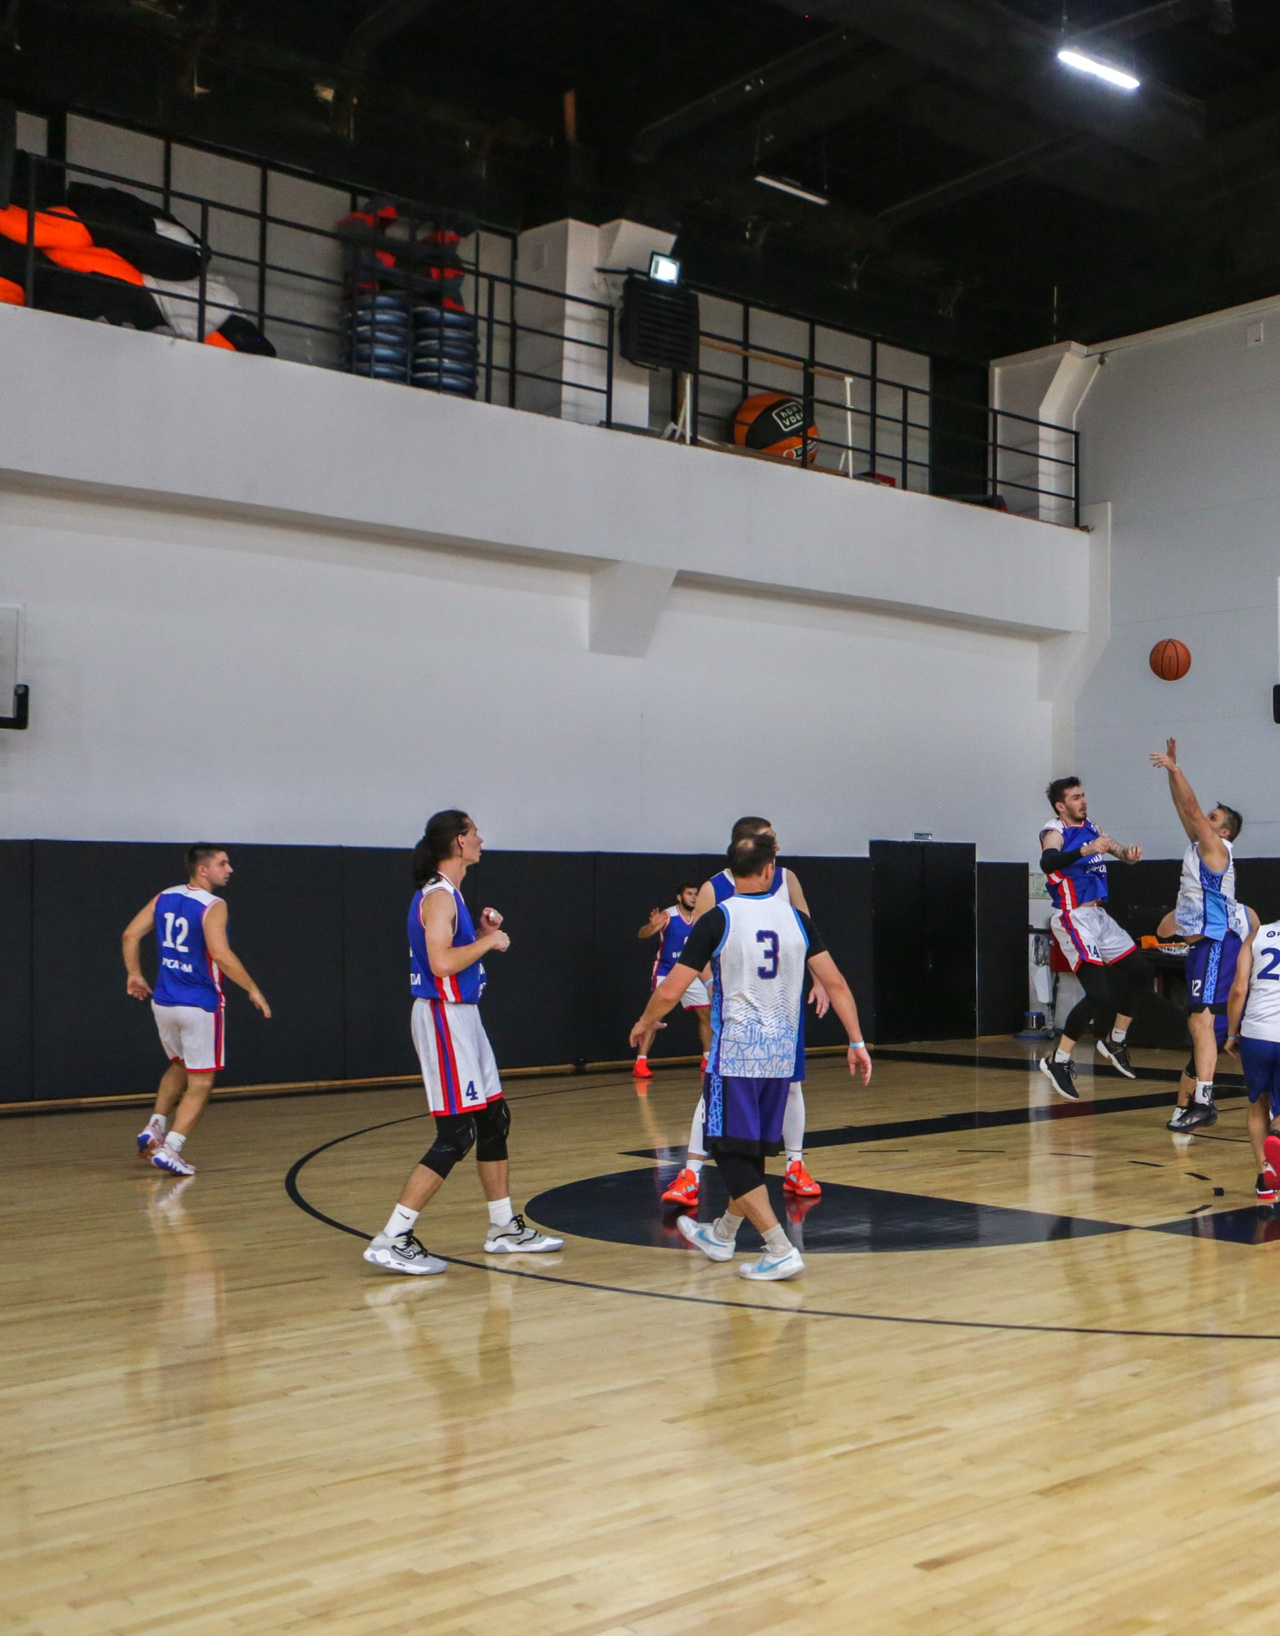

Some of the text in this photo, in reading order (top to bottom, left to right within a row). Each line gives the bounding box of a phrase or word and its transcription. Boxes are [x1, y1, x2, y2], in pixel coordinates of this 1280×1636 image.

[162, 912, 189, 953] 12
[756, 929, 780, 980] 3
[465, 1080, 479, 1101] 4
